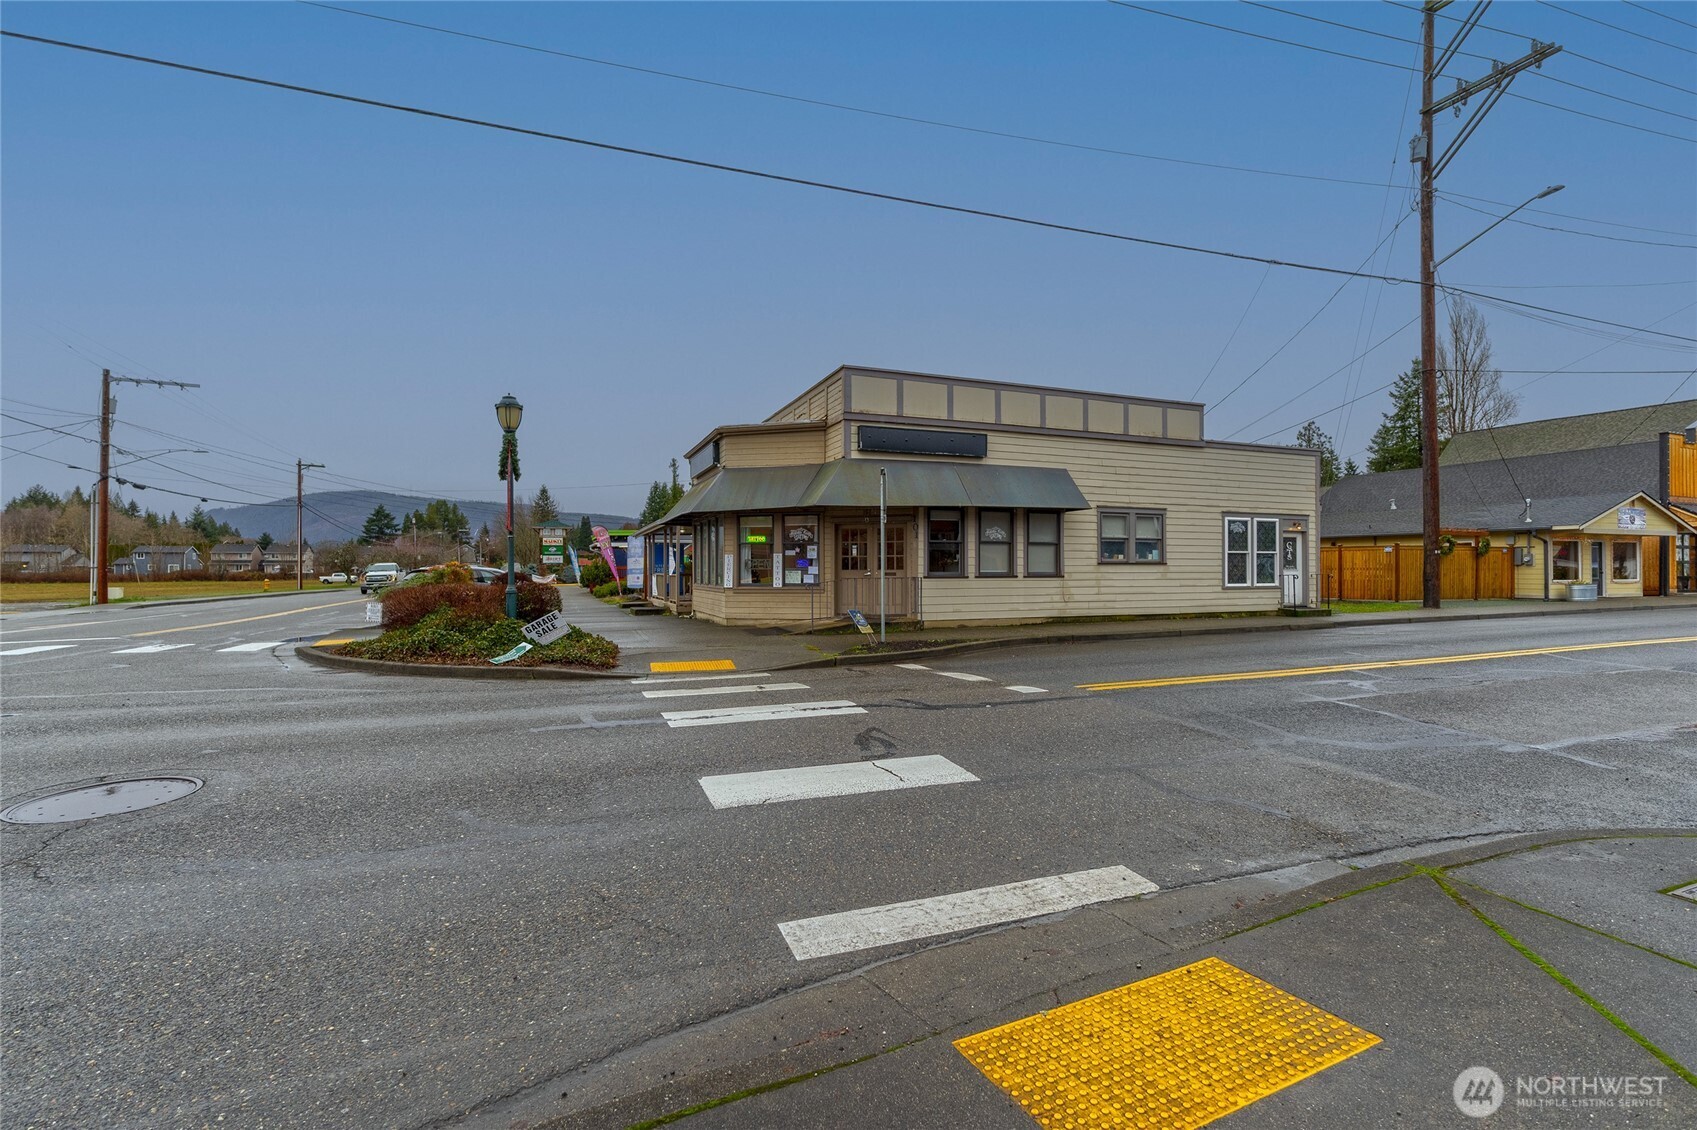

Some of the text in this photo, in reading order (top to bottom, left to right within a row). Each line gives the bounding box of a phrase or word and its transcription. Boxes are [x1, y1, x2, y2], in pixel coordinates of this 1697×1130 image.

[745, 559, 772, 569] OPEN
[524, 612, 559, 634] GARAGE
[535, 622, 558, 638] SALE
